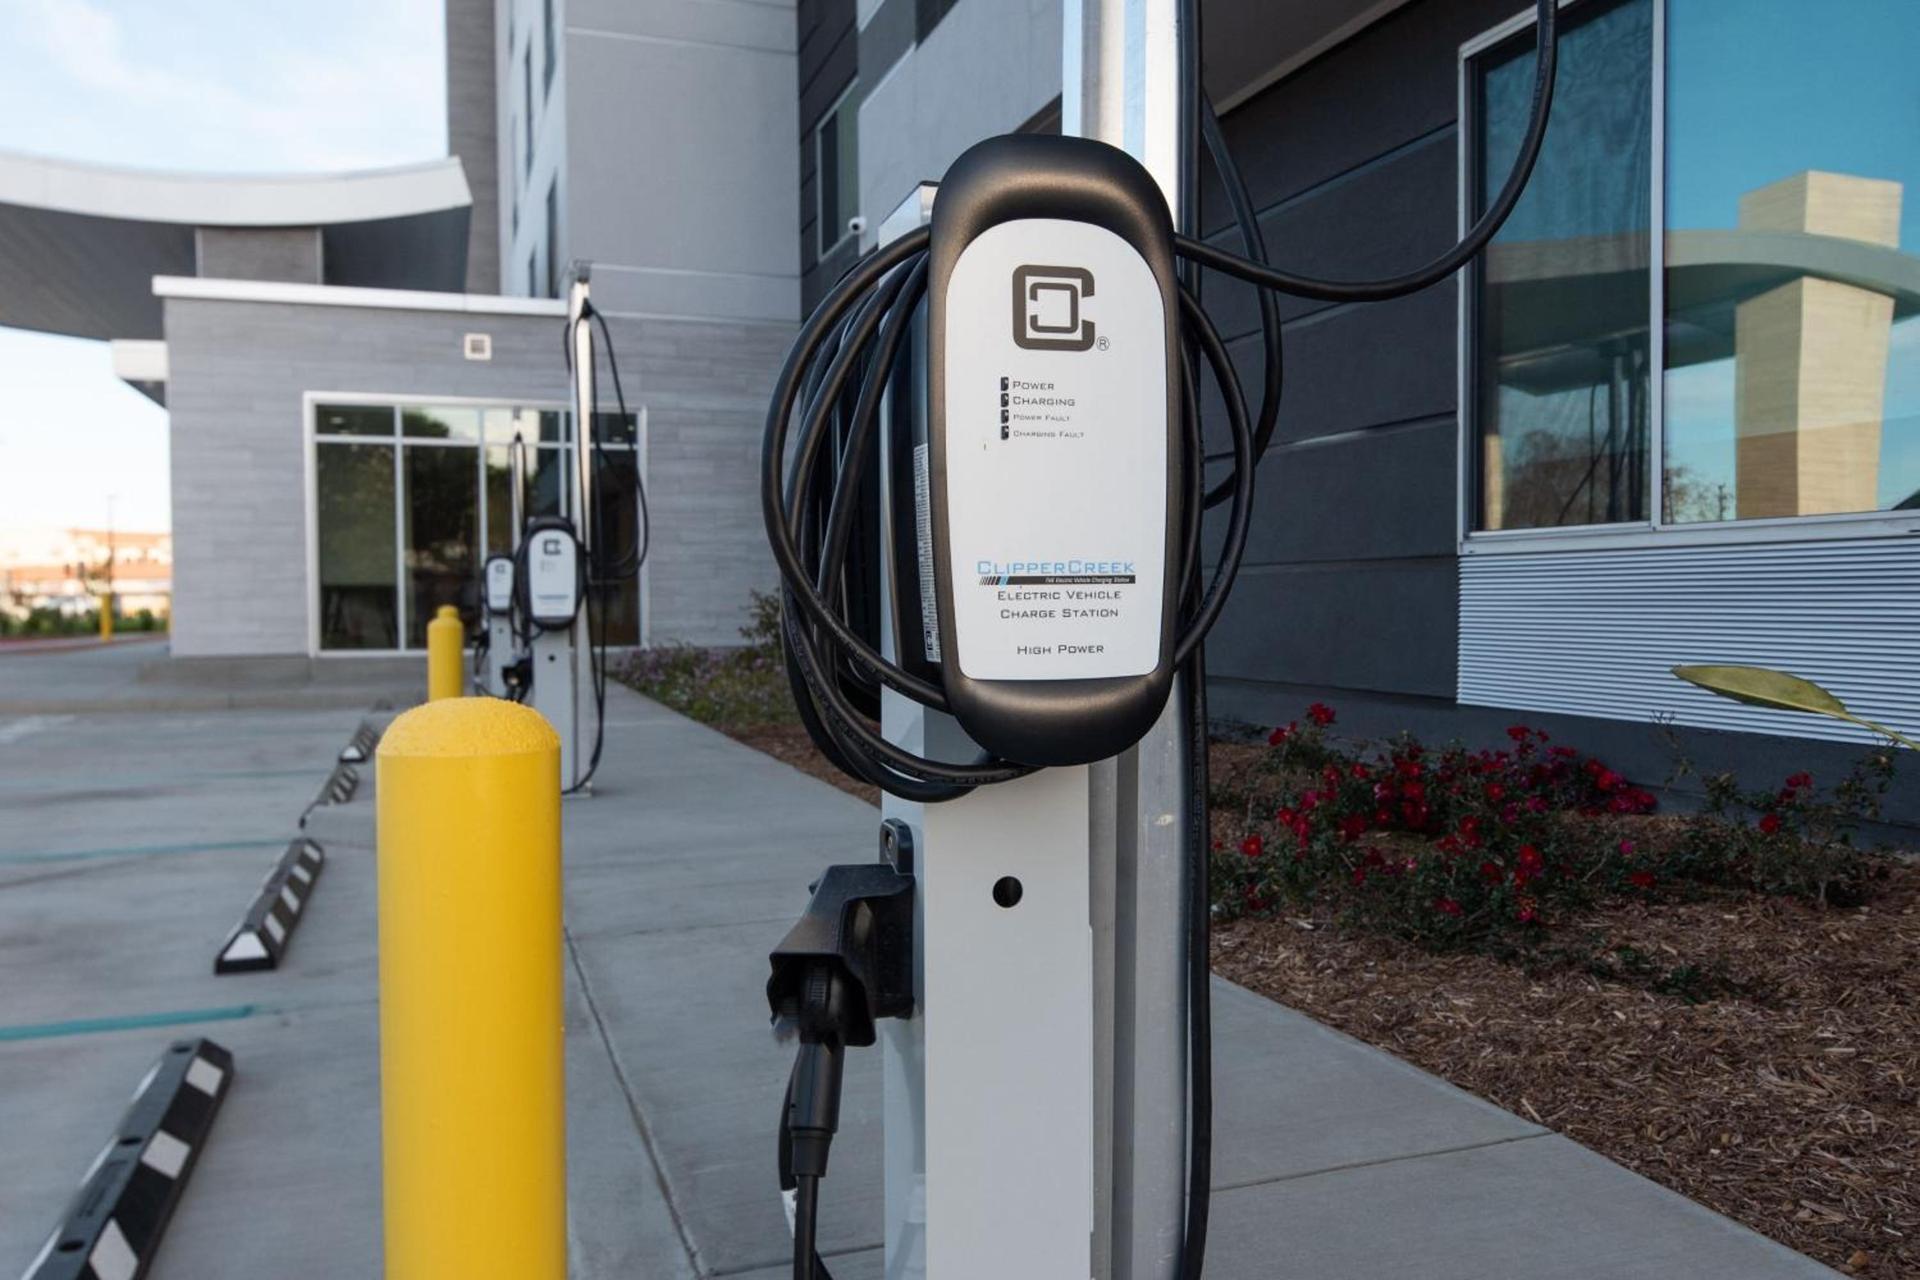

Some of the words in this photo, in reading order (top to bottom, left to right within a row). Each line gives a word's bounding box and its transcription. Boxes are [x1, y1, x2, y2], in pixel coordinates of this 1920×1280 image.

[1012, 380, 1055, 391] POWER
[1012, 396, 1076, 407] CHARGING
[997, 590, 1061, 601] ELECTRIC
[1065, 590, 1122, 600] VEHICLE
[1000, 608, 1057, 619] CHARGE
[1061, 608, 1119, 618] STATION
[1016, 645, 1052, 655] HIGH
[1057, 644, 1105, 654] POWER
